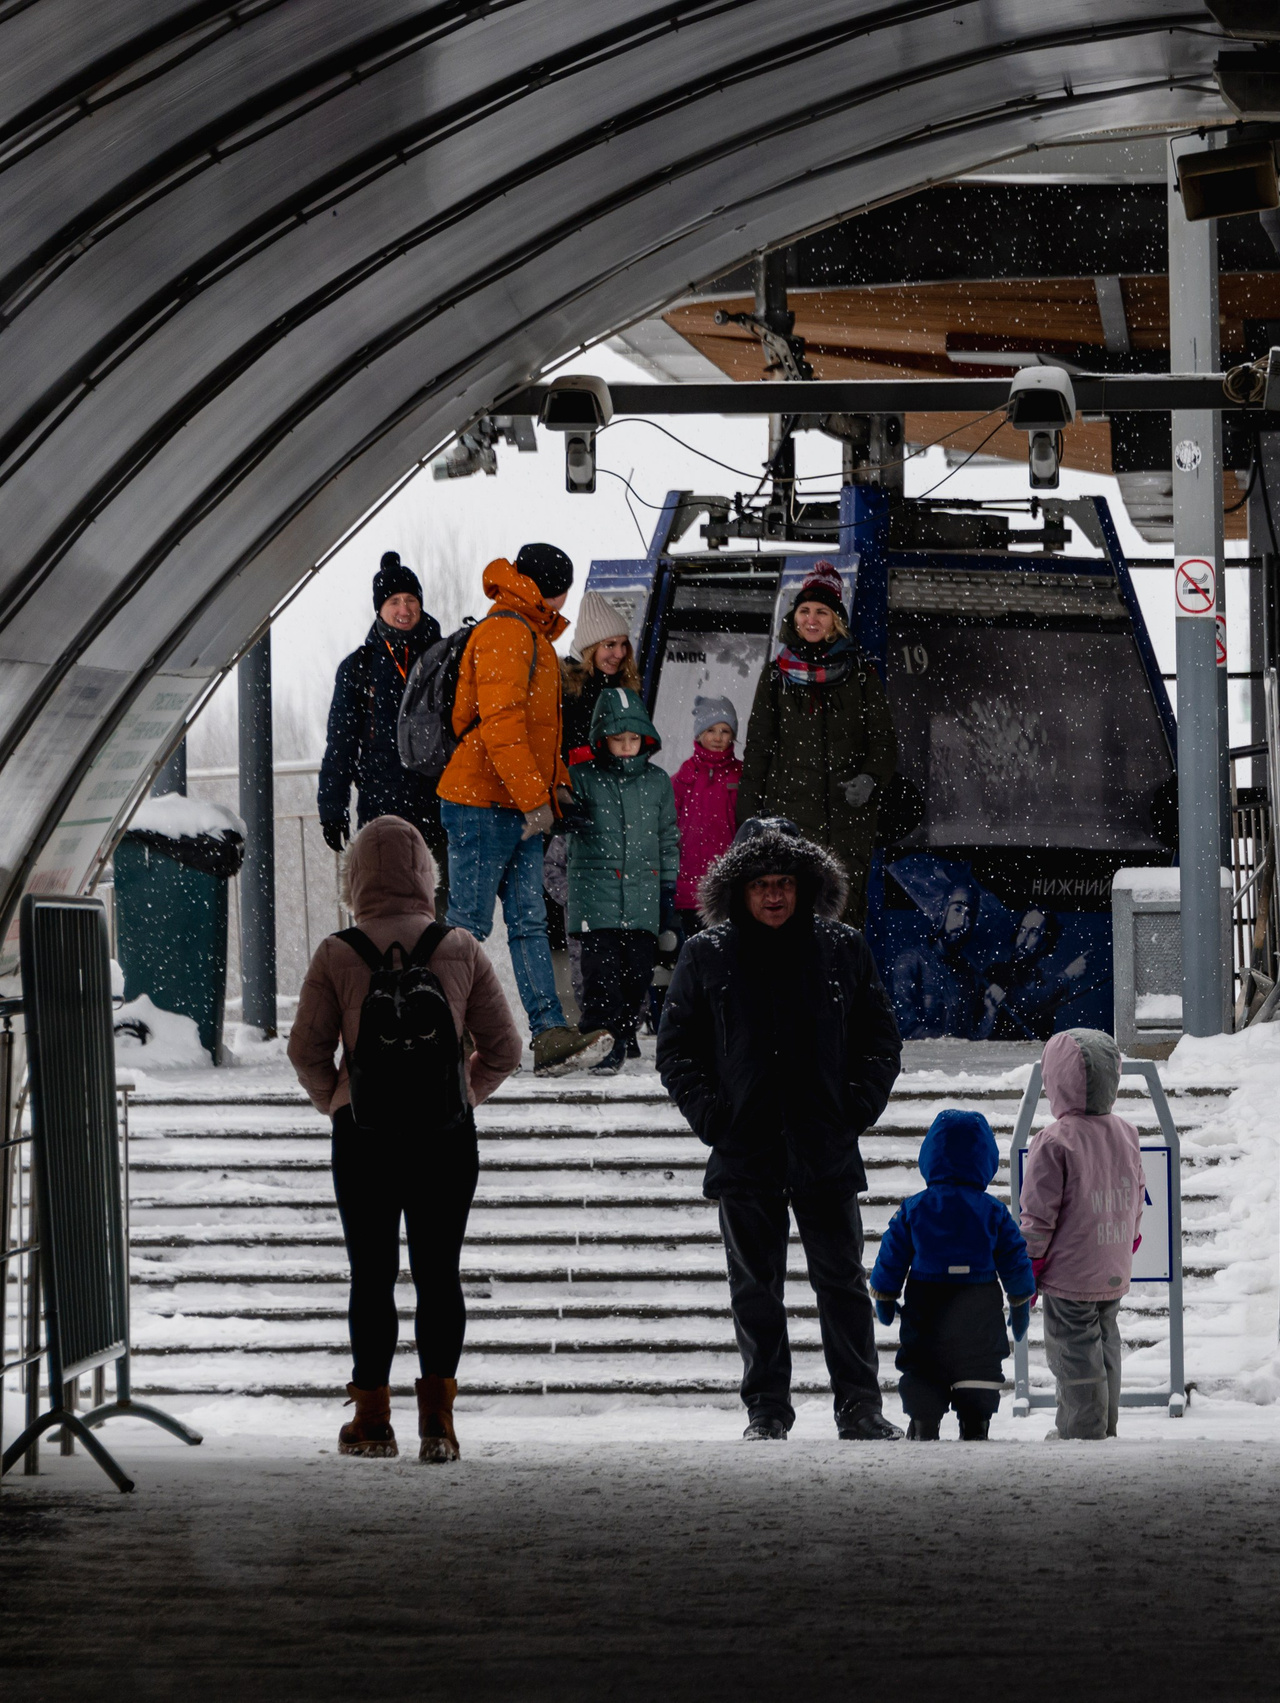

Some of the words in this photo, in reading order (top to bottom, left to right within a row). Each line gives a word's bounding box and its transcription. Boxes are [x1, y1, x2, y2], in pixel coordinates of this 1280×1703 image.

[901, 644, 930, 676] 19
[1031, 875, 1113, 897] НИЖНИЙ
[1090, 1187, 1132, 1215] WHITE
[1096, 1220, 1128, 1246] BEAR
